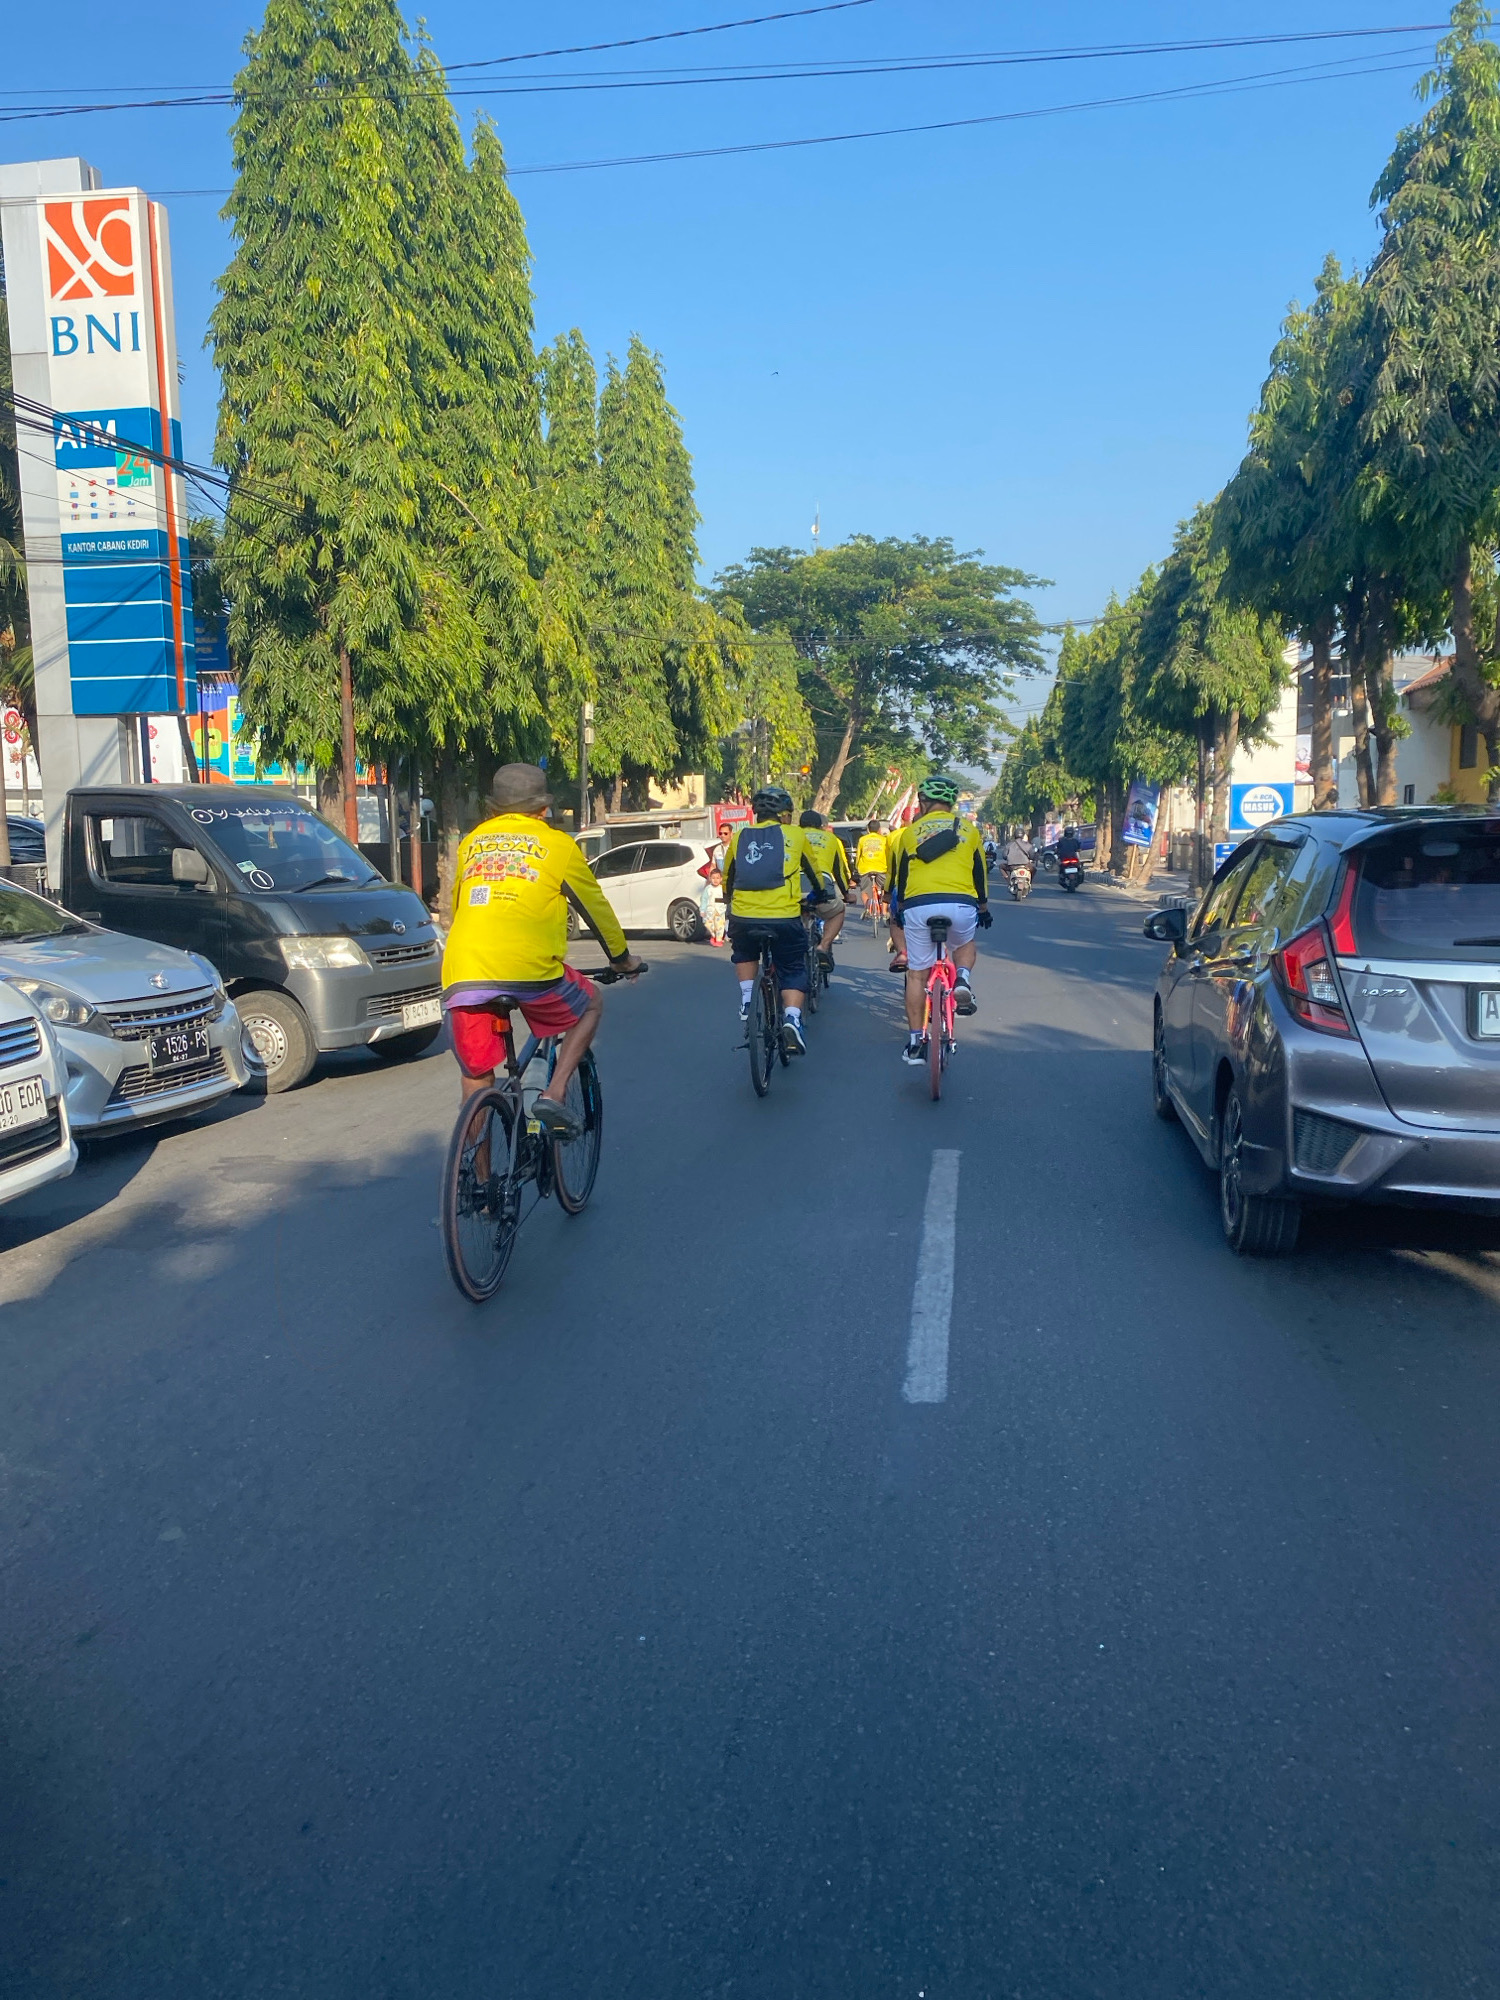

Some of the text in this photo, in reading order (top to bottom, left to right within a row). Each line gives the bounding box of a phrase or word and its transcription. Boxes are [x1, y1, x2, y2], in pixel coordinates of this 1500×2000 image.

[50, 311, 141, 357] BNI
[56, 419, 118, 450] ATM
[117, 451, 151, 475] 24
[128, 476, 149, 487] Jam
[67, 539, 149, 553] KANTOR CABANG KEDIRI
[1244, 802, 1274, 812] MASUK
[463, 841, 548, 864] JAGOAN
[1486, 993, 1500, 1020] A
[151, 1030, 207, 1059] S 1526 PS
